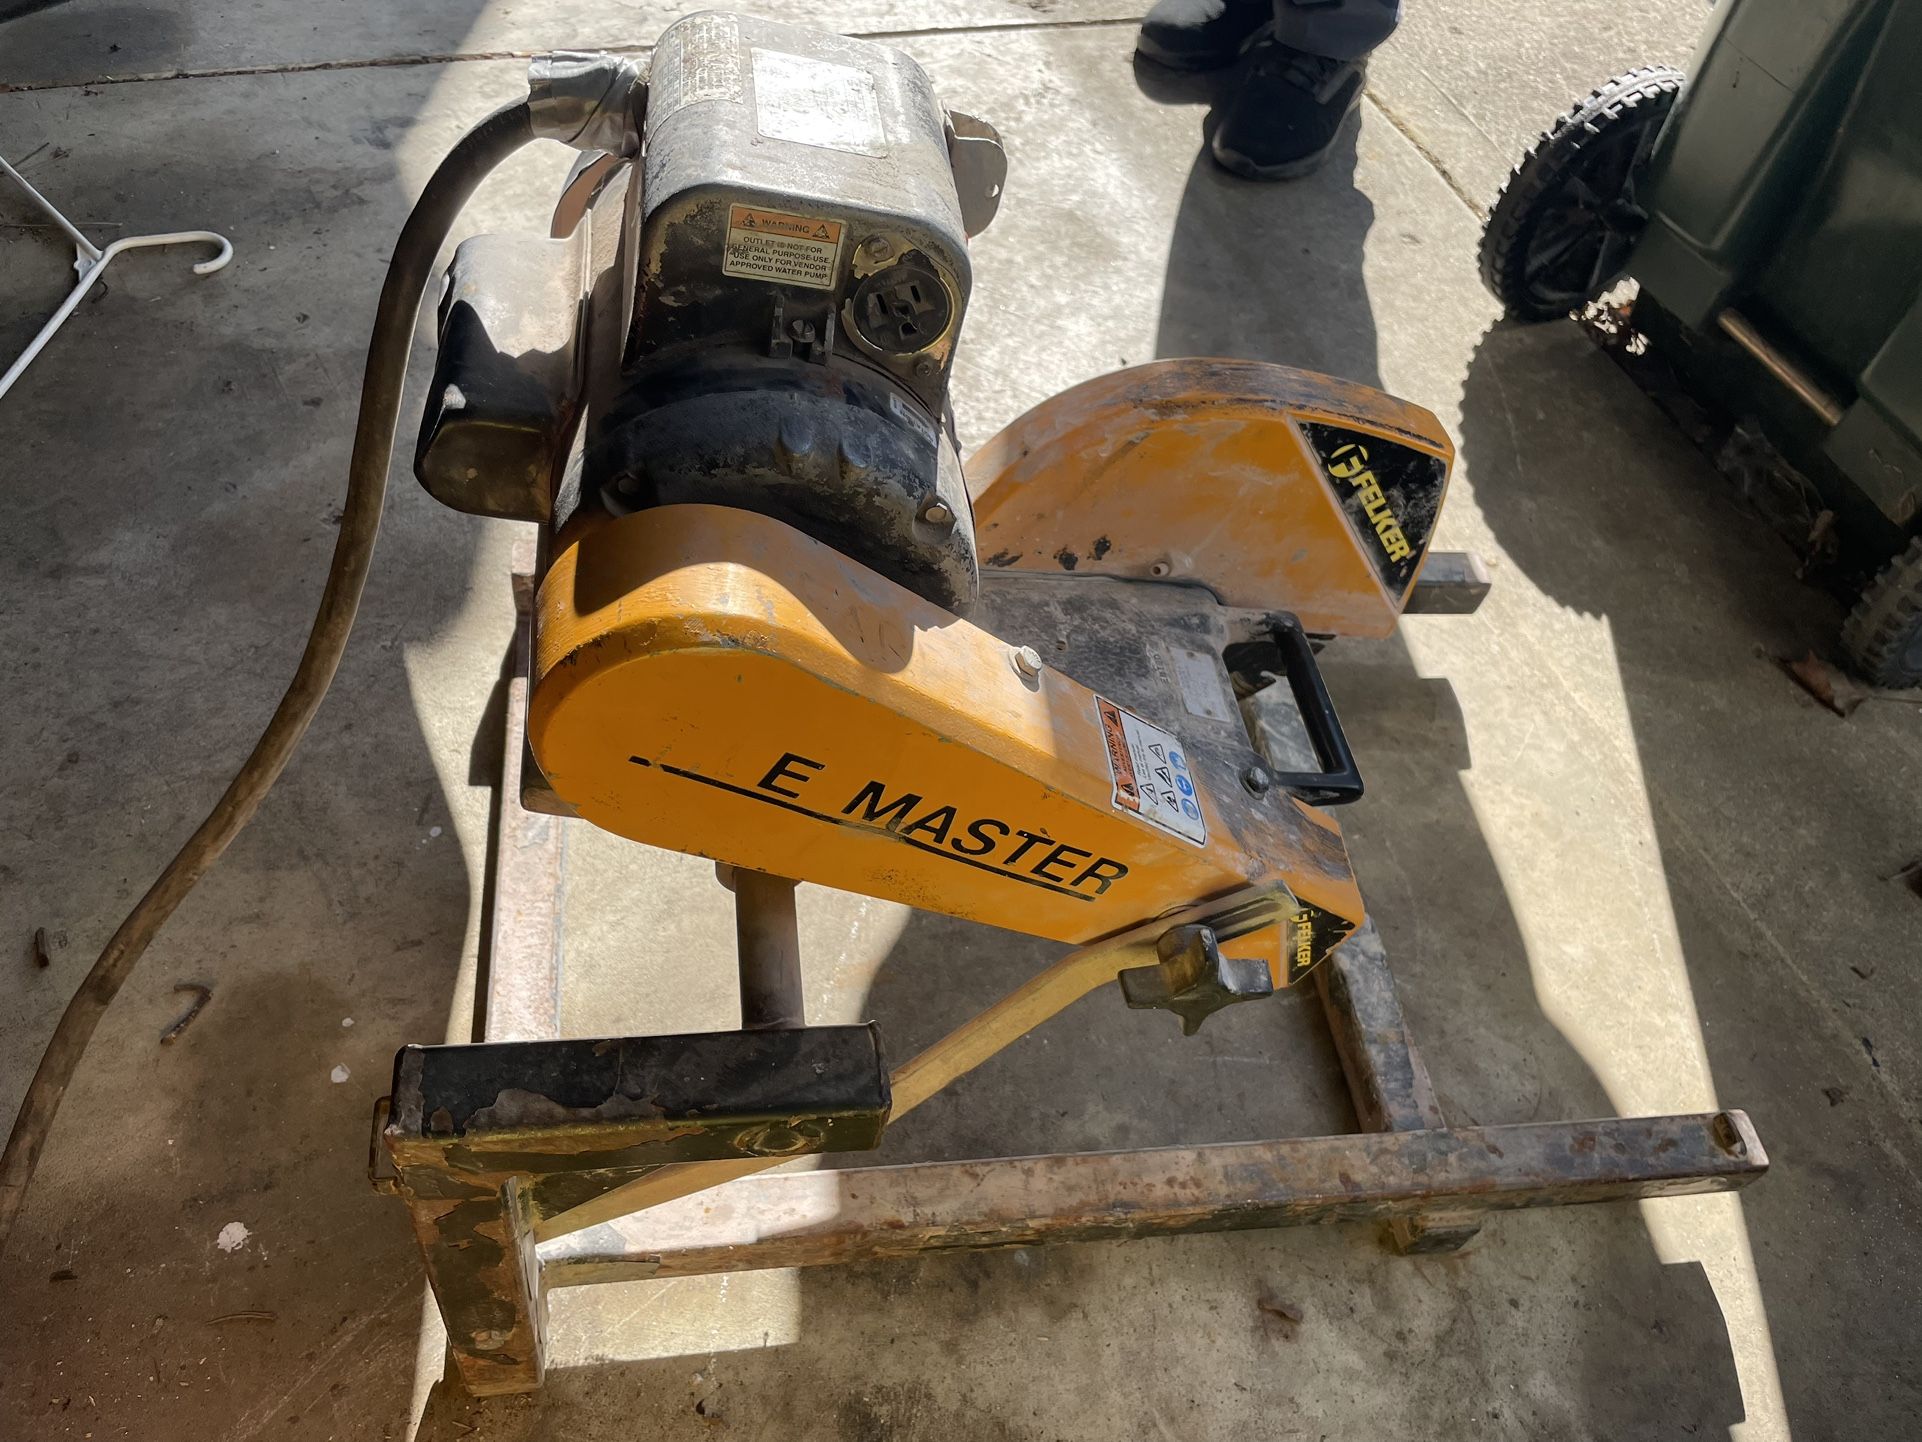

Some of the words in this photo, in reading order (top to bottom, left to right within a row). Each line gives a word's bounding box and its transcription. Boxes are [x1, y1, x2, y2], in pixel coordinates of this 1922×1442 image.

[732, 243, 770, 255] GENERAL
[772, 248, 811, 260] PURPOSE
[743, 236, 776, 247] OUTLET
[787, 242, 805, 251] NOT
[806, 245, 823, 254] FOR
[730, 260, 774, 272] APPROVED
[775, 266, 803, 277] WATER
[733, 251, 750, 260] USE
[752, 254, 773, 264] ONLY
[775, 258, 792, 267] FOR
[794, 260, 827, 272] VENDOR
[1351, 470, 1411, 563] FELKER
[841, 780, 1129, 895] MASTER
[1297, 922, 1312, 967] FELKER
